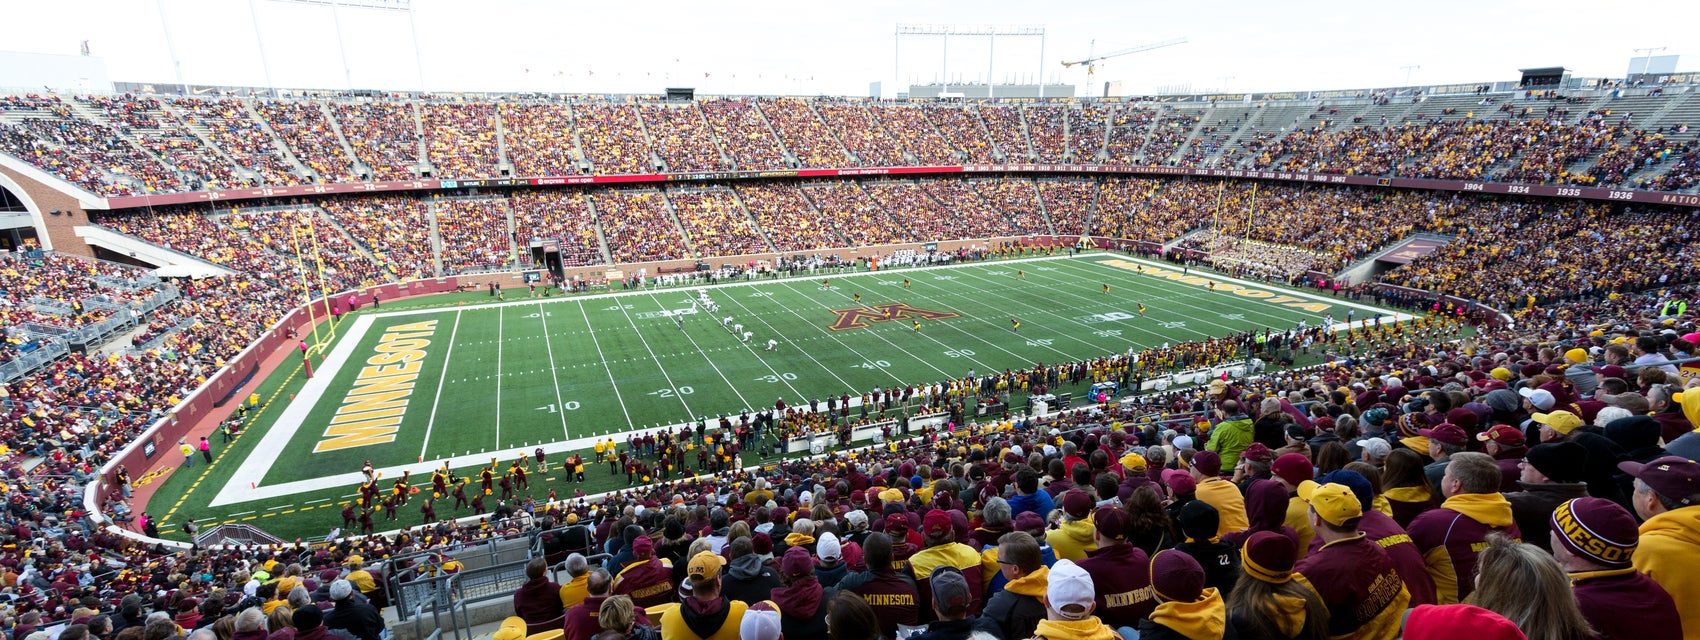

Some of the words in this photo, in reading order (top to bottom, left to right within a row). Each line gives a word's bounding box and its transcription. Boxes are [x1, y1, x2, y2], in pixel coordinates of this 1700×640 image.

[1463, 183, 1483, 191] 1904
[1508, 185, 1529, 194] 1934
[1557, 188, 1581, 196] 1935
[1609, 191, 1633, 200] 1936
[1662, 195, 1700, 205] NATIO
[1095, 259, 1333, 313] MINNESOTA
[943, 349, 976, 358] 50
[861, 360, 891, 370] 40
[763, 371, 798, 384] 30
[312, 319, 438, 454] MINNESOTA
[656, 385, 695, 398] 20
[547, 400, 581, 413] 10
[1555, 499, 1636, 561] NNESOT
[1218, 554, 1230, 566] 22
[863, 592, 915, 607] MINNESOTA
